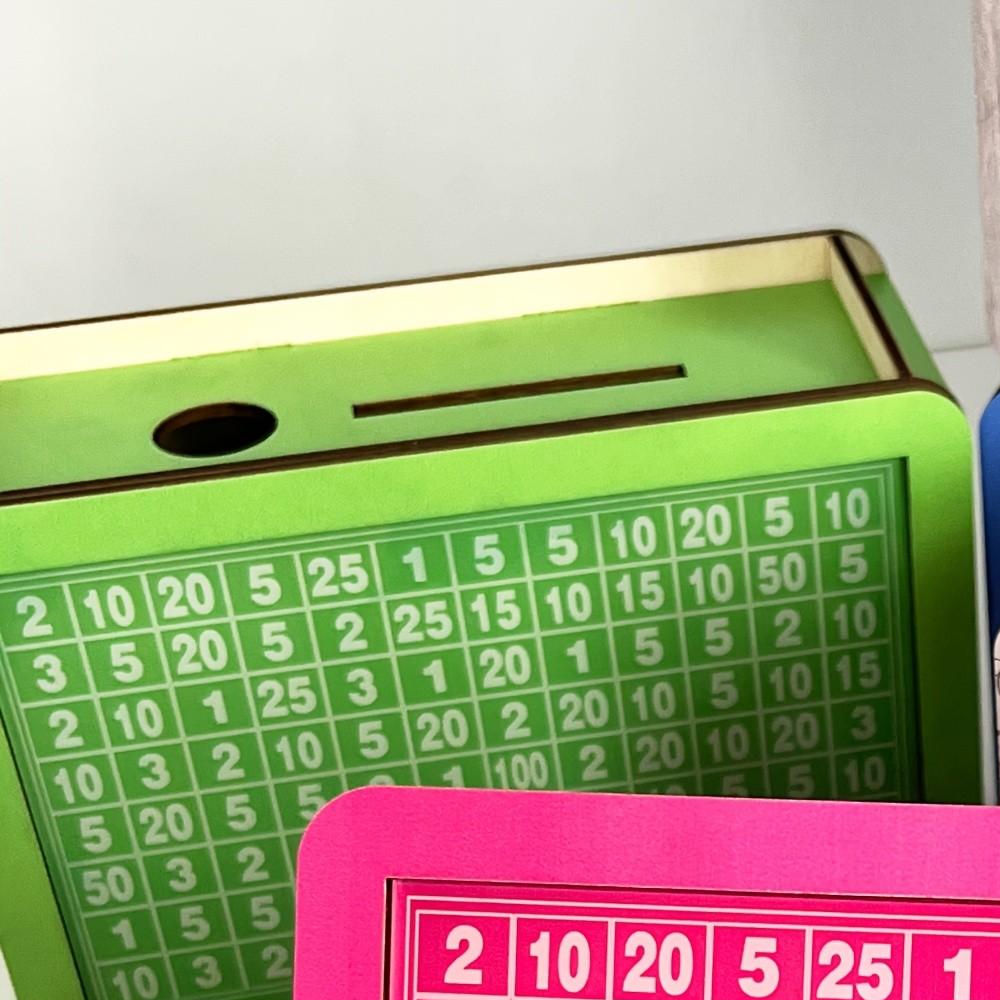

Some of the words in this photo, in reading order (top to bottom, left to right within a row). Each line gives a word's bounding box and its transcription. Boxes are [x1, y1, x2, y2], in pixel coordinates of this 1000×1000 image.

[15, 595, 54, 638] 2
[82, 584, 135, 629] 10
[157, 572, 215, 619] 20
[248, 563, 282, 606] 5
[307, 552, 369, 598] 25
[401, 545, 427, 583] 1
[473, 533, 505, 576] 5
[547, 523, 579, 566] 5
[609, 515, 657, 559] 10
[679, 503, 732, 550] 20
[764, 495, 794, 538] 5
[824, 487, 870, 530] 10
[32, 653, 68, 694] 3
[109, 641, 144, 683] 5
[171, 629, 228, 675] 20
[260, 621, 294, 662] 5
[334, 611, 369, 653] 2
[393, 600, 453, 644] 25
[470, 589, 521, 633] 15
[545, 582, 592, 625] 10
[615, 570, 665, 613] 15
[688, 563, 734, 606] 10
[758, 551, 807, 595] 50
[839, 543, 869, 584] 5
[444, 924, 484, 985] 2
[529, 931, 591, 993] 10
[622, 931, 694, 996] 20
[738, 936, 780, 998] 5
